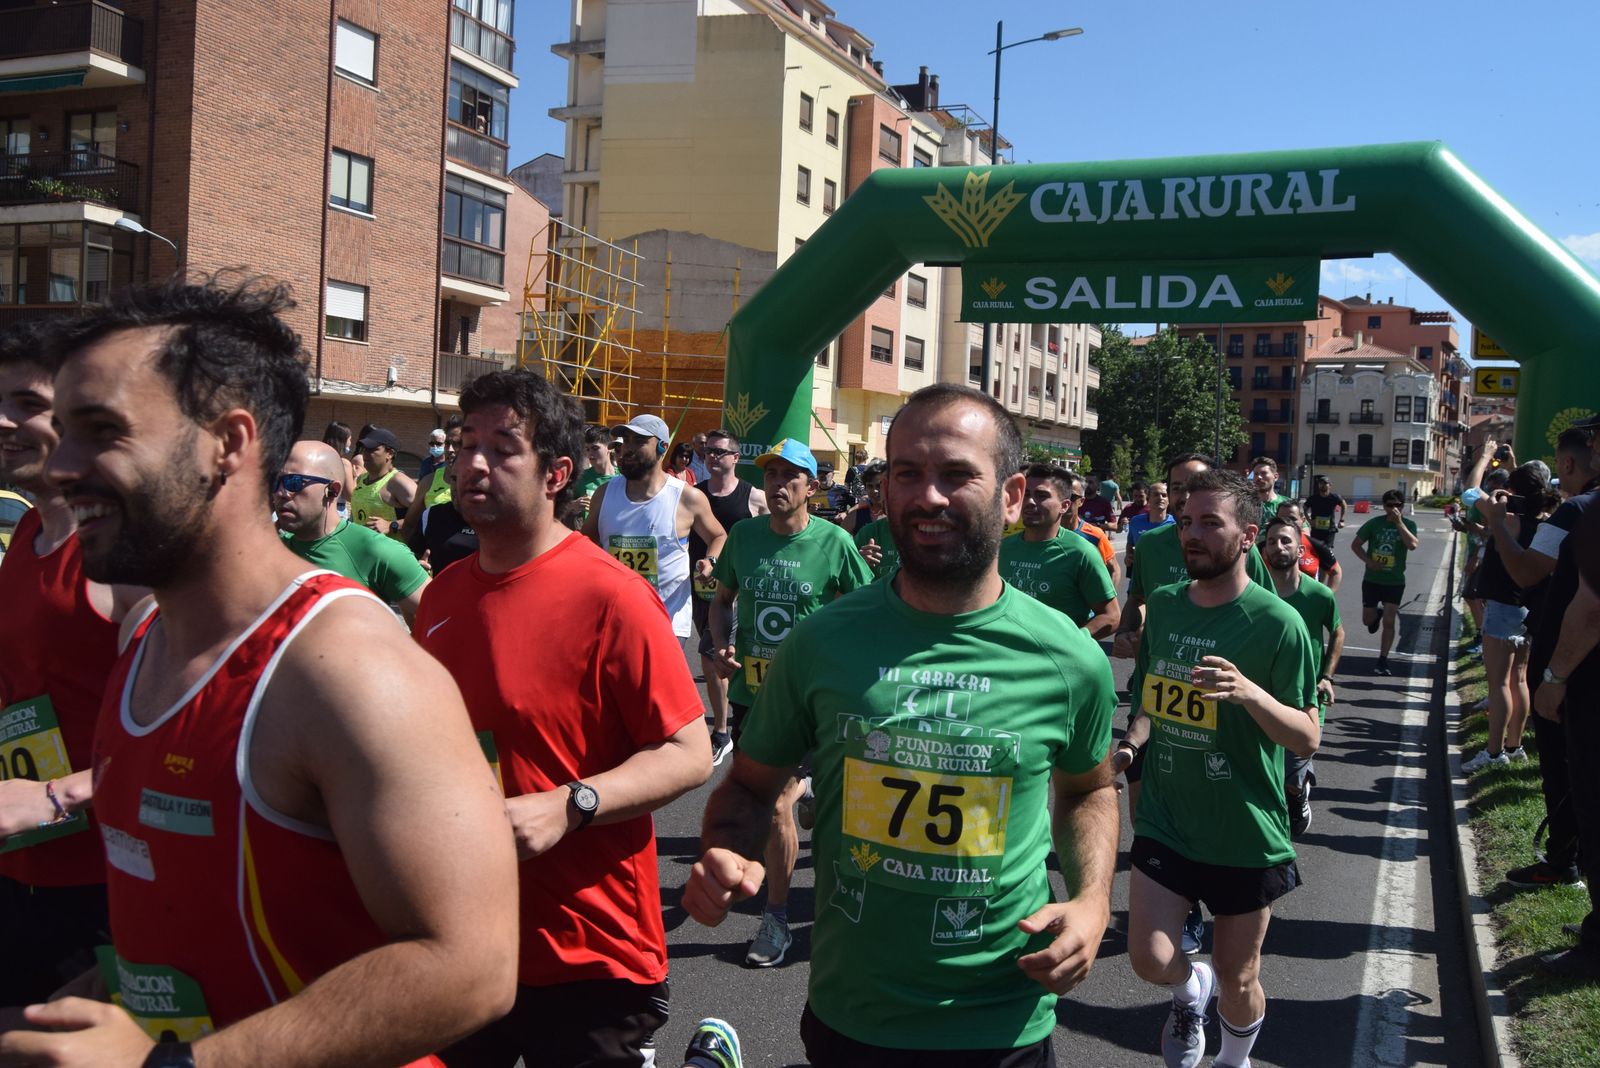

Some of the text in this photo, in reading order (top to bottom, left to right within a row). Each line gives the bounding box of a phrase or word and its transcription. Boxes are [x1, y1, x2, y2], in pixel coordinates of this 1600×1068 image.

[1030, 169, 1355, 224] CAJA RURAL
[1023, 274, 1243, 310] SALIDA
[911, 670, 991, 693] CARRERA
[1151, 681, 1205, 721] 126
[1161, 724, 1212, 743] CAJA RURAL
[895, 736, 993, 758] FUNDACION
[894, 752, 992, 773] CAJA RURAL
[881, 776, 965, 846] 75
[882, 858, 992, 883] CAJA RURAL
[955, 929, 979, 938] RURAL
